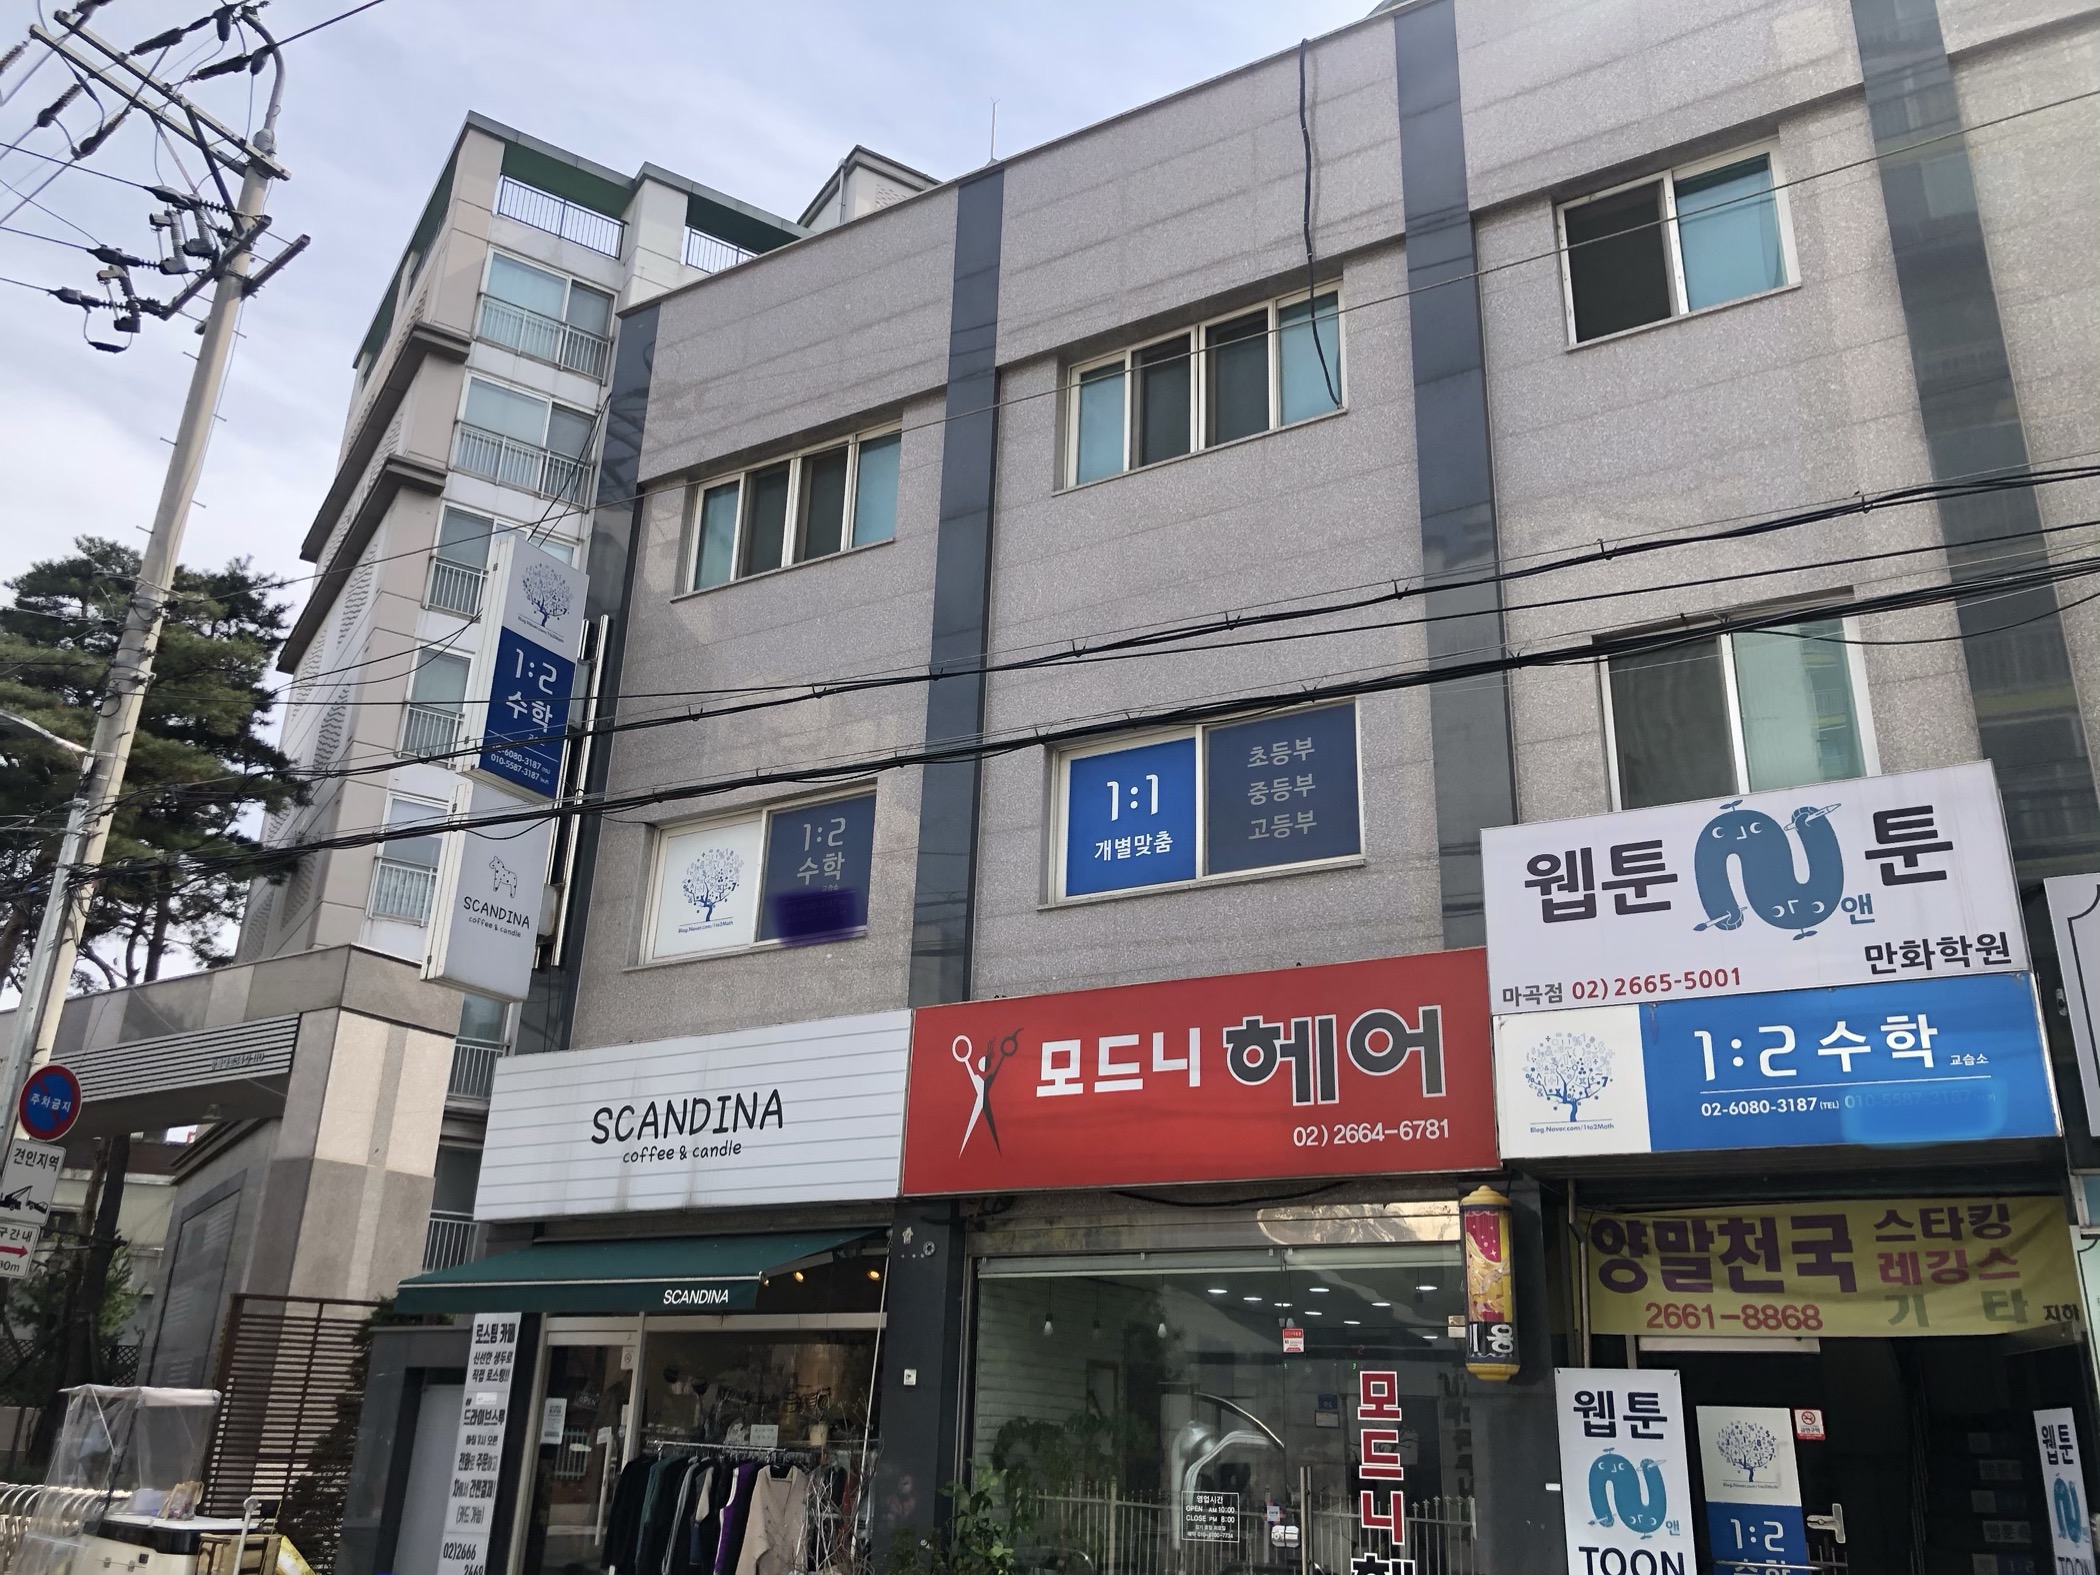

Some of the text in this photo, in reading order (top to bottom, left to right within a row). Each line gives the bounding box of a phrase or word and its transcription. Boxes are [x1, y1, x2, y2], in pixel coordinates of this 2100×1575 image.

[516, 648, 558, 695] 1:2
[505, 690, 553, 733] 수학
[490, 753, 540, 781] 010-5587-3187
[1247, 737, 1316, 769] 초등부
[1106, 773, 1159, 822] 1:1
[1247, 773, 1317, 806] 중등부
[803, 817, 847, 852] 1:2
[1247, 809, 1318, 841] 고등부
[1093, 830, 1174, 862] 개별맞춤
[796, 851, 846, 886] 수학
[1523, 803, 1954, 924] 웹툰 툰
[463, 895, 530, 930] SCANDINA
[1839, 892, 1876, 926] 앤
[468, 915, 493, 930] coffee
[499, 925, 522, 938] candle
[1864, 931, 2012, 976] 만화학원
[1501, 982, 1563, 1009] 마곡점
[1035, 1004, 1448, 1107] 모드니 헤어
[1693, 1012, 1990, 1082] 1:2 수학 교습소
[30, 1092, 72, 1113] 주차금지
[591, 1088, 783, 1145] SCANDINA
[1700, 1095, 1818, 1118] 02-6080-3187
[13, 1147, 60, 1172] 견인지역
[622, 1139, 742, 1164] coffee & candle
[1873, 1203, 2013, 1243] 스타킹
[1590, 1213, 1858, 1295] 양말천국
[1877, 1247, 2021, 1286] 레깅스
[662, 1288, 730, 1305] SCANDINA
[2043, 1303, 2080, 1322] 지하
[475, 1322, 516, 1344] 로스팅 카페
[1644, 1302, 1824, 1332] 2661-8868
[473, 1351, 513, 1365] 신선한 생두로
[472, 1369, 485, 1382] 직접
[578, 1395, 596, 1407] OPEN
[1573, 1390, 1668, 1440] 웹툰
[463, 1409, 506, 1426] 드라이브스루
[1357, 1371, 1405, 1546] 모드니
[2041, 1424, 2074, 1465] 웹툰
[458, 1452, 476, 1471] 전화로
[1196, 1495, 1224, 1504] 영업시간
[1185, 1514, 1207, 1522] CLOSE
[1665, 1519, 1681, 1536] 앤
[443, 1541, 477, 1561] 02)2666
[1730, 1518, 1785, 1552] 1:2
[1578, 1546, 1686, 1575] TOON
